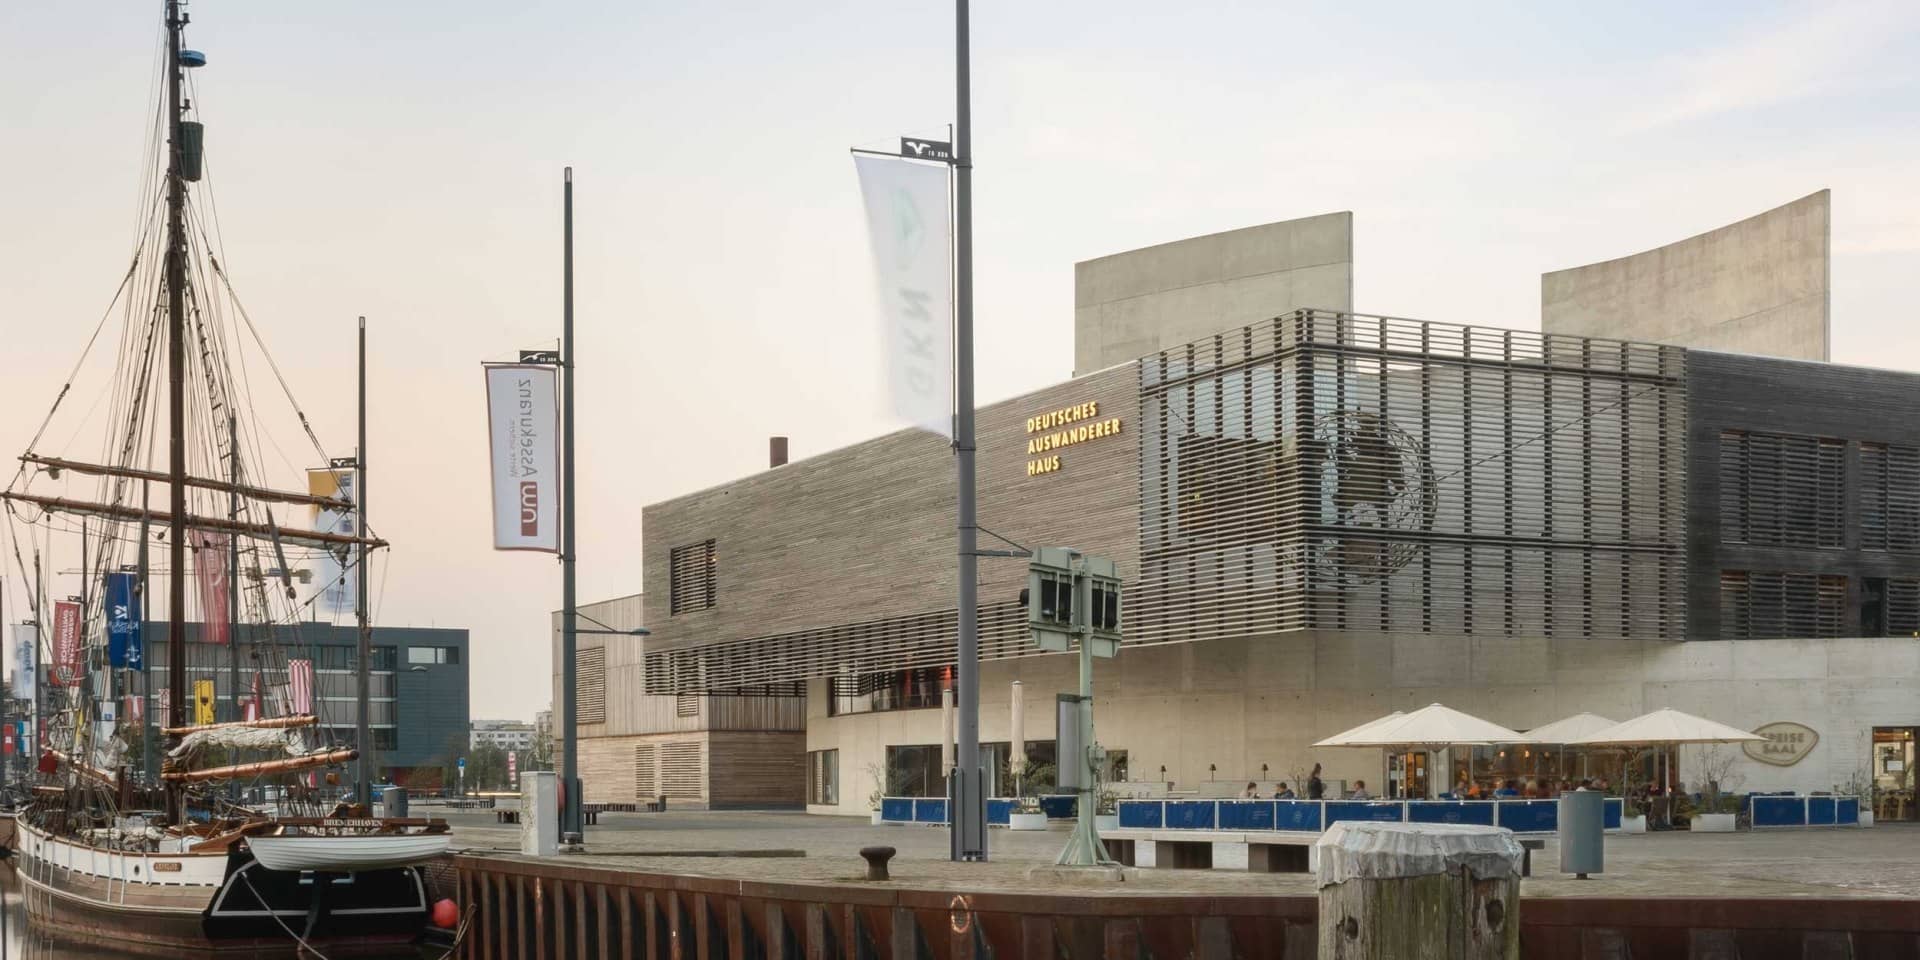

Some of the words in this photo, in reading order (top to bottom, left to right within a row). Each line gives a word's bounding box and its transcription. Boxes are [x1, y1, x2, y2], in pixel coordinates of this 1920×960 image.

[1027, 401, 1098, 433] DEUTSCHES
[1028, 418, 1121, 454] AUSWANDERER
[1028, 455, 1060, 476] HAUS
[1762, 743, 1796, 755] SAAL
